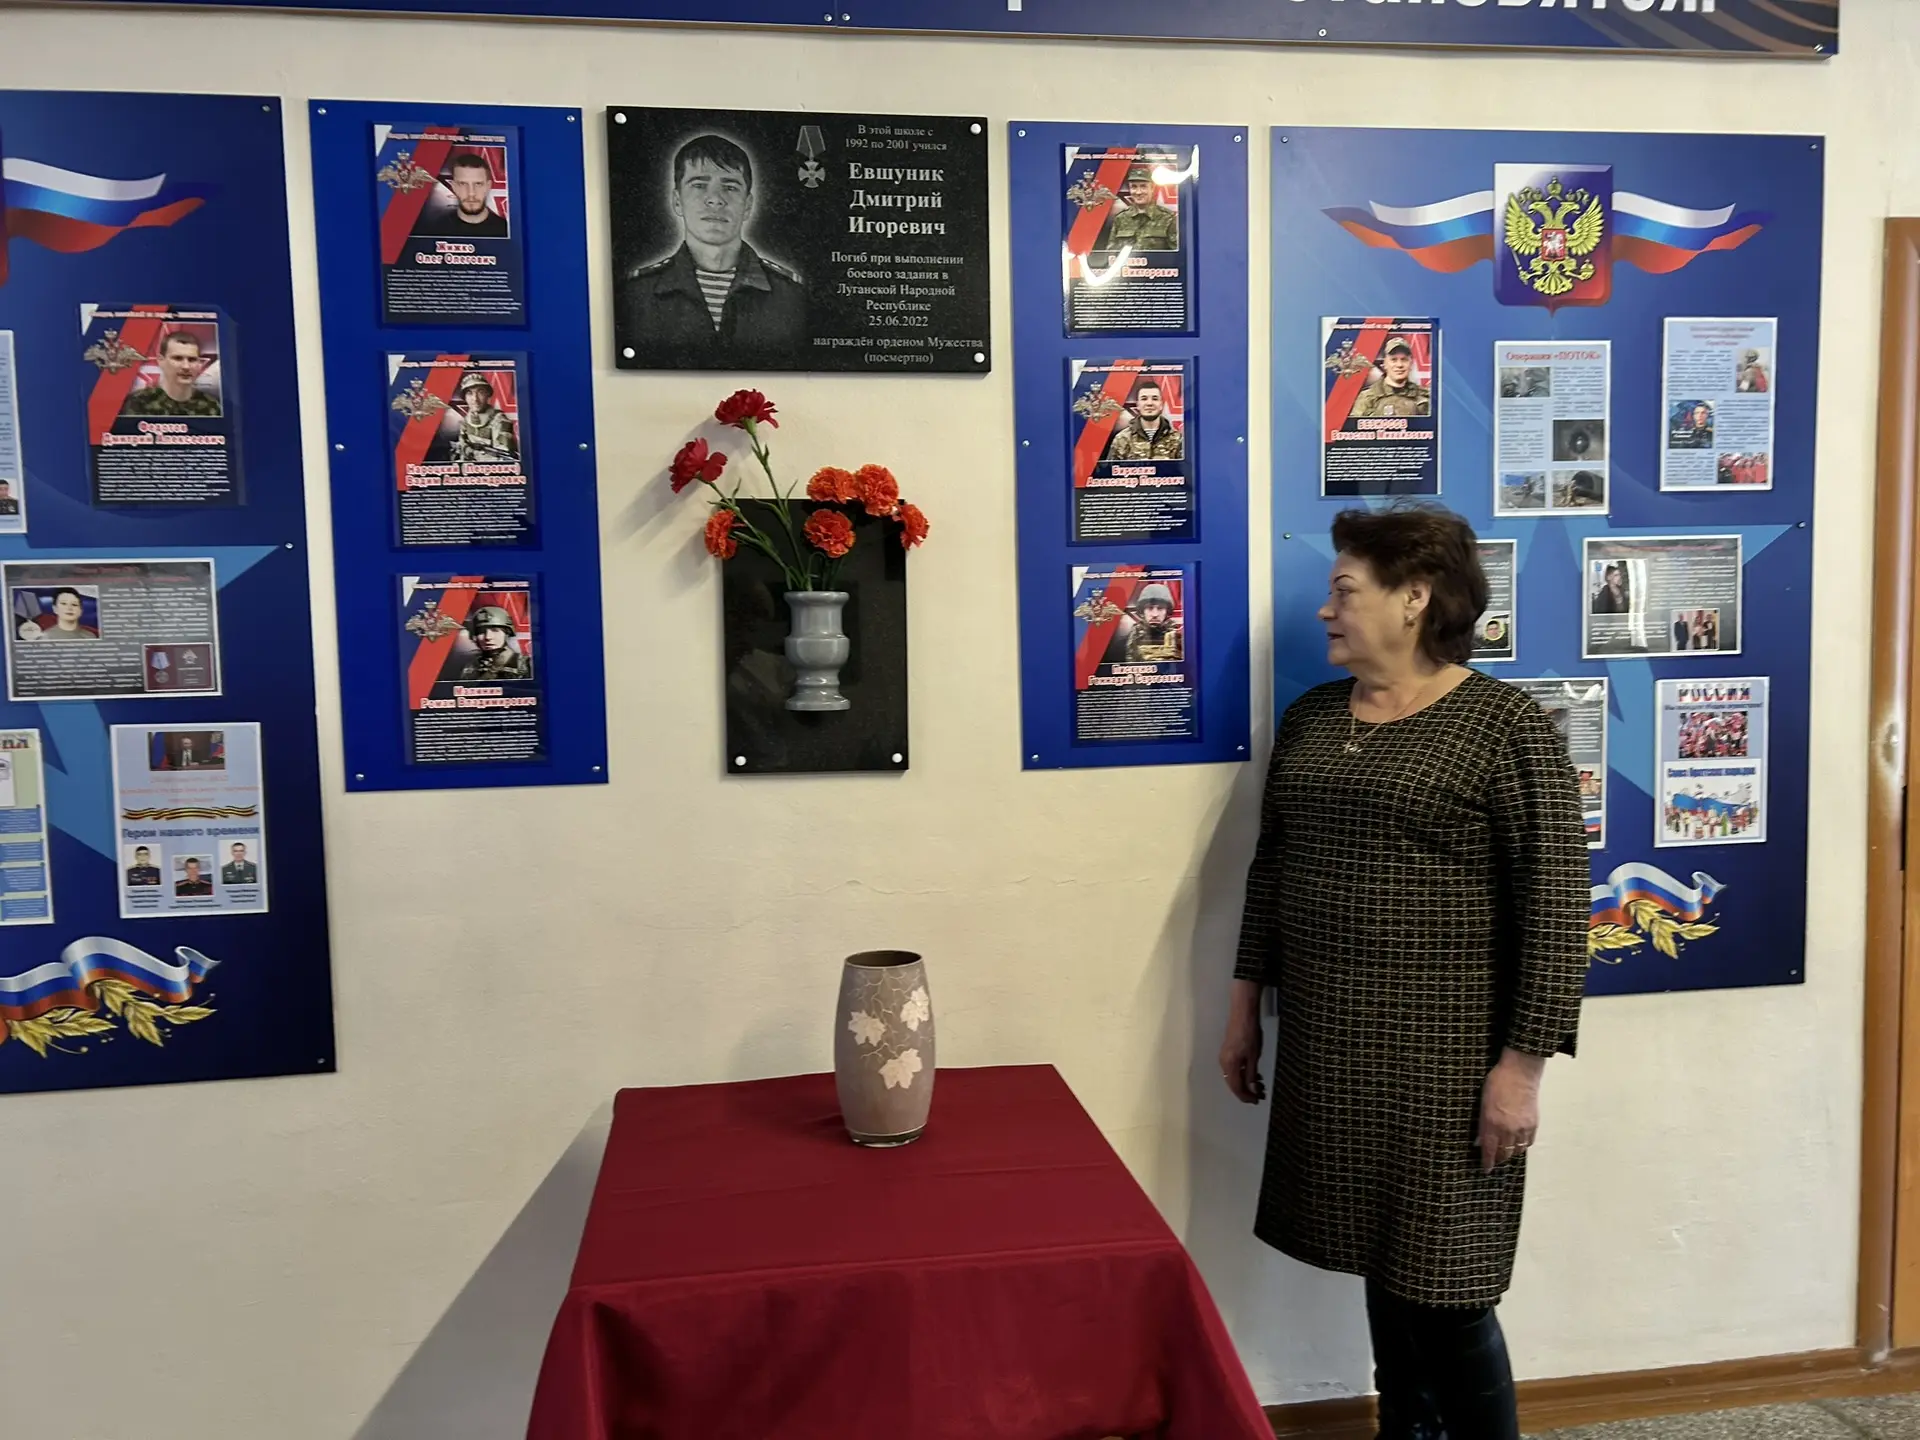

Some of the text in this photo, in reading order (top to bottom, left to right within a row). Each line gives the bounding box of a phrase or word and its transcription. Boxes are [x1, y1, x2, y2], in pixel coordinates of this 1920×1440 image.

[857, 124, 866, 134] В
[868, 125, 891, 135] этой
[894, 127, 924, 136] школе
[845, 138, 947, 151] 1992 по 2001 учился
[849, 162, 944, 184] Евшуник
[850, 189, 942, 212] Дмитрий
[848, 216, 946, 238] Игоревич
[831, 251, 964, 265] Погиб при выполнении
[846, 268, 949, 280] боевого задания в
[836, 283, 956, 297] Луганской Народной
[866, 300, 931, 313] Республике
[868, 315, 929, 327] 25.06.2022
[813, 337, 983, 350] награждён орденом Мужества
[864, 352, 934, 365] (посмертно)
